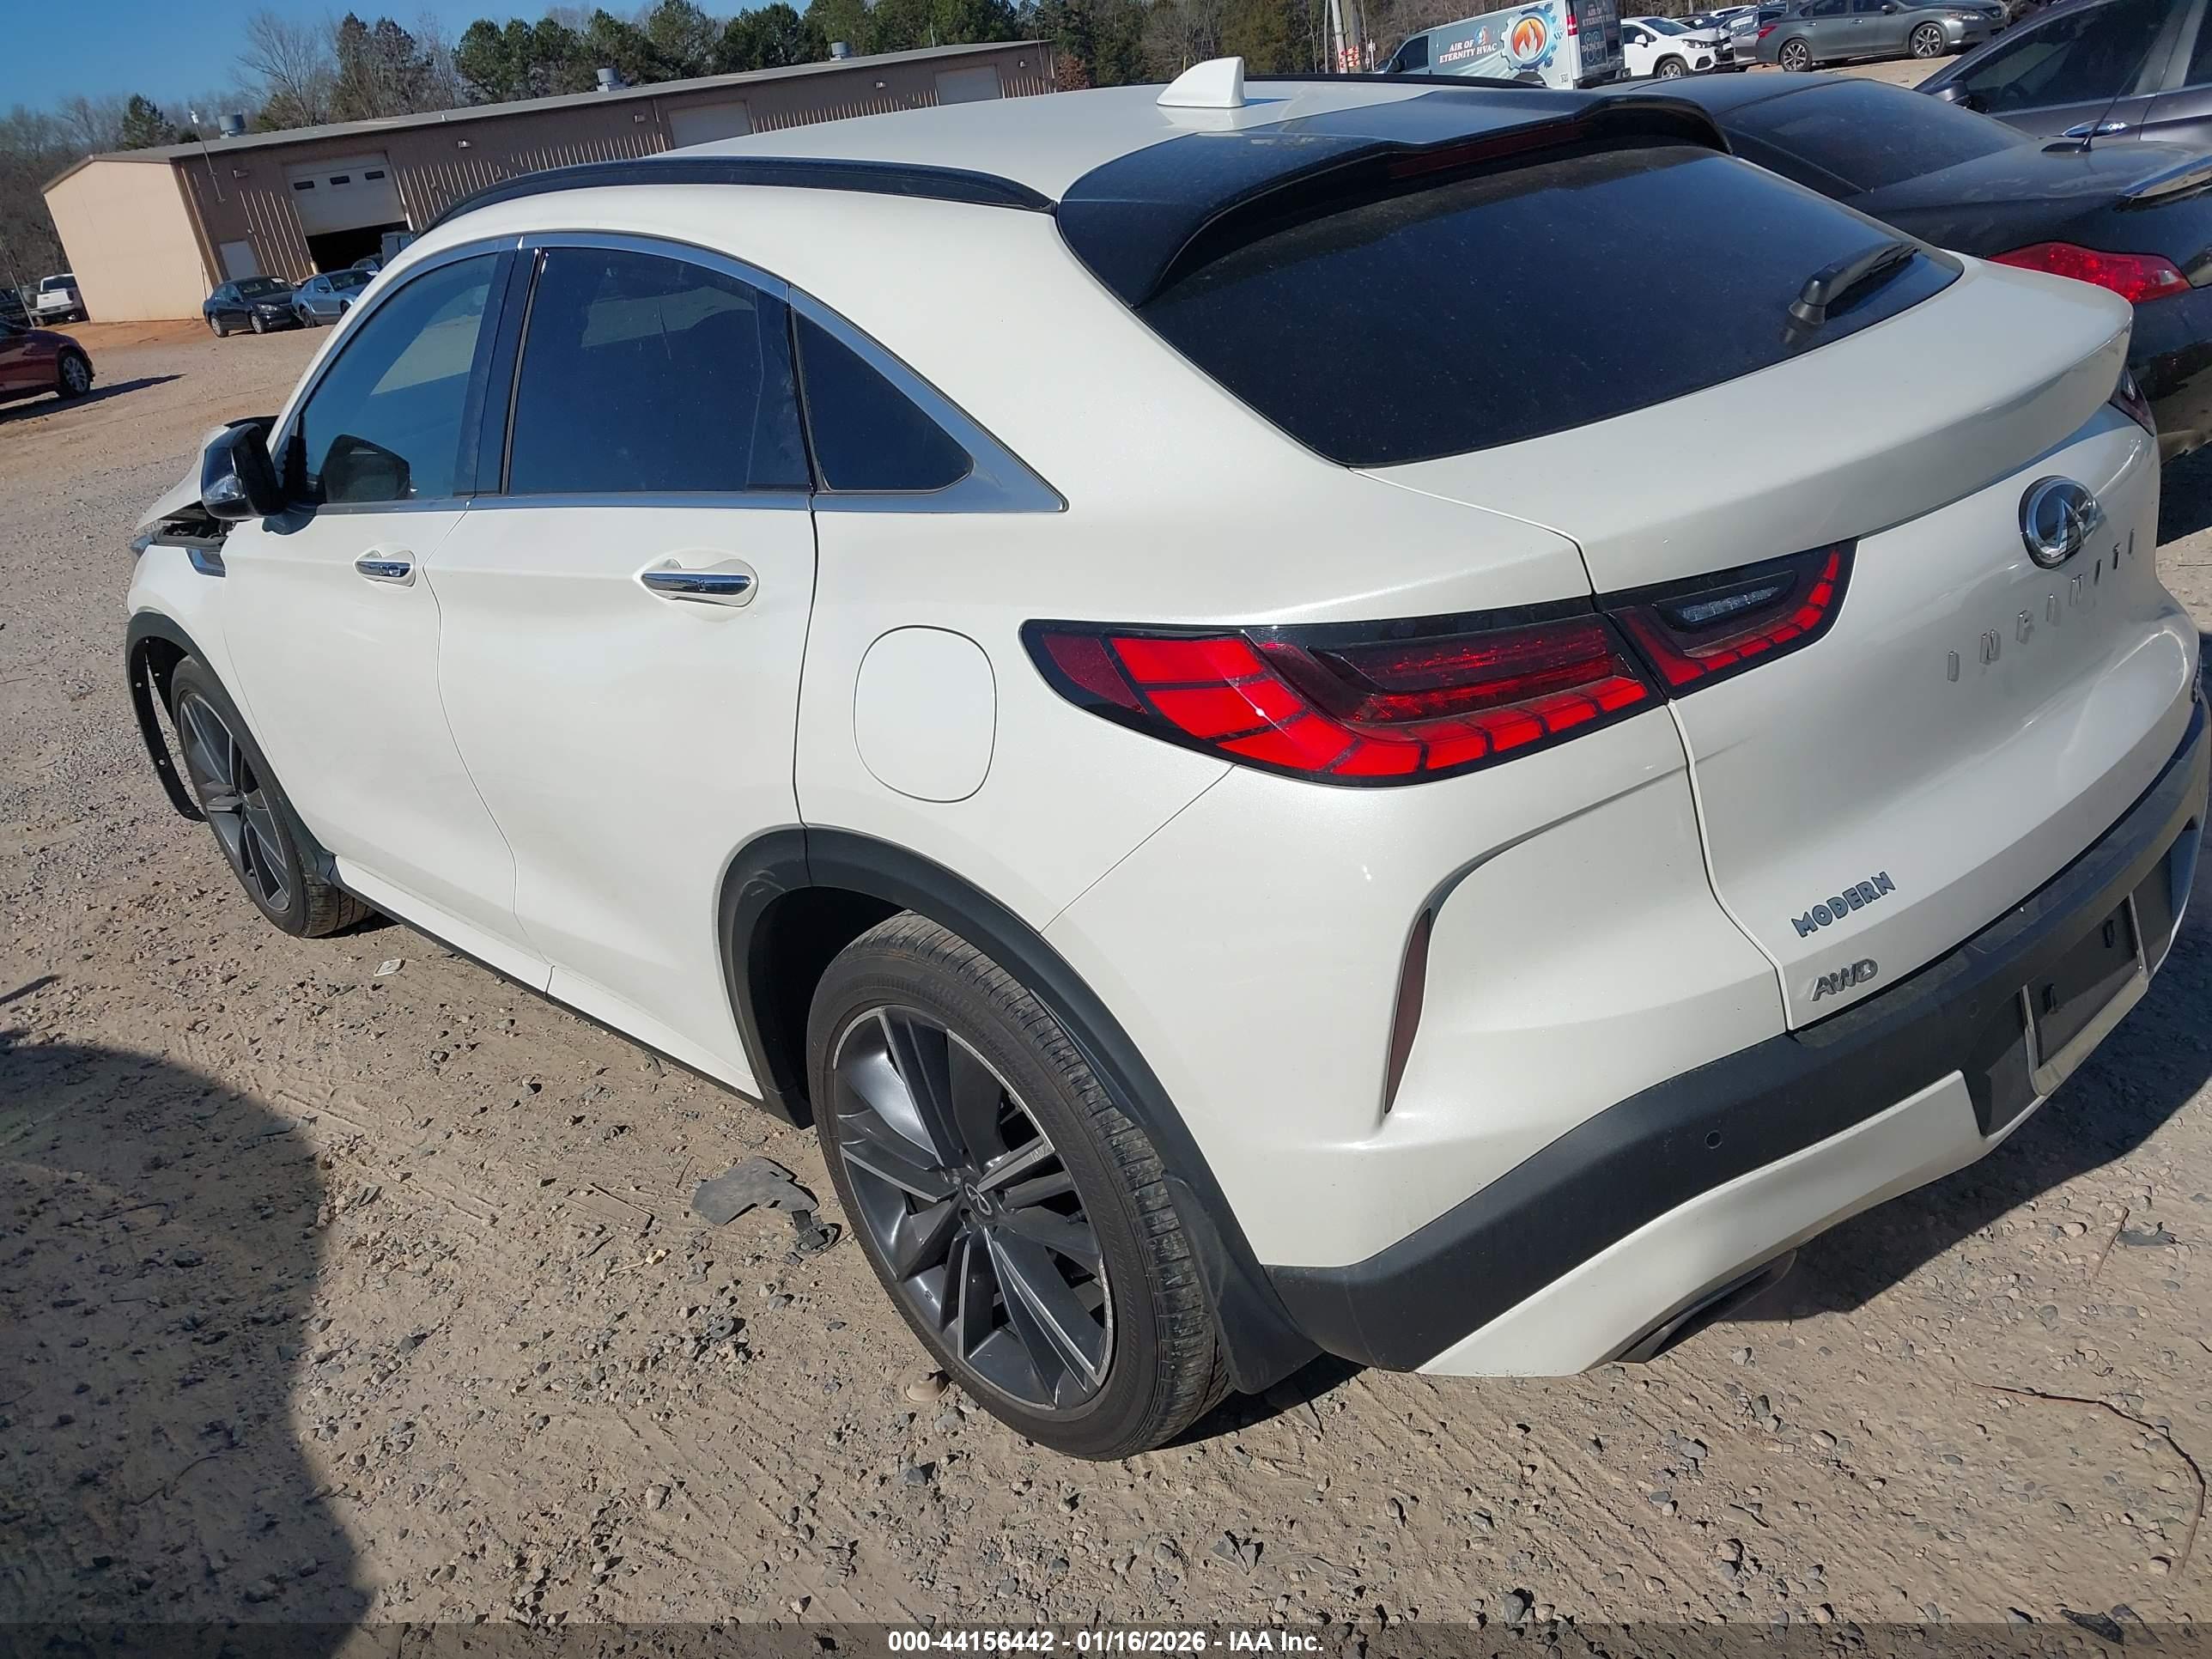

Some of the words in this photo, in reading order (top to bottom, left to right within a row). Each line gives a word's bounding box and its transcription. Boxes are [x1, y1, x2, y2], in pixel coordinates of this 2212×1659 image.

[1439, 48, 1476, 64] ETERNITY
[1477, 43, 1498, 55] HVAC
[1449, 42, 1462, 52] AIR
[1463, 40, 1474, 49] OF
[1790, 871, 1896, 939] MODERN
[1809, 957, 1879, 1002] AWD
